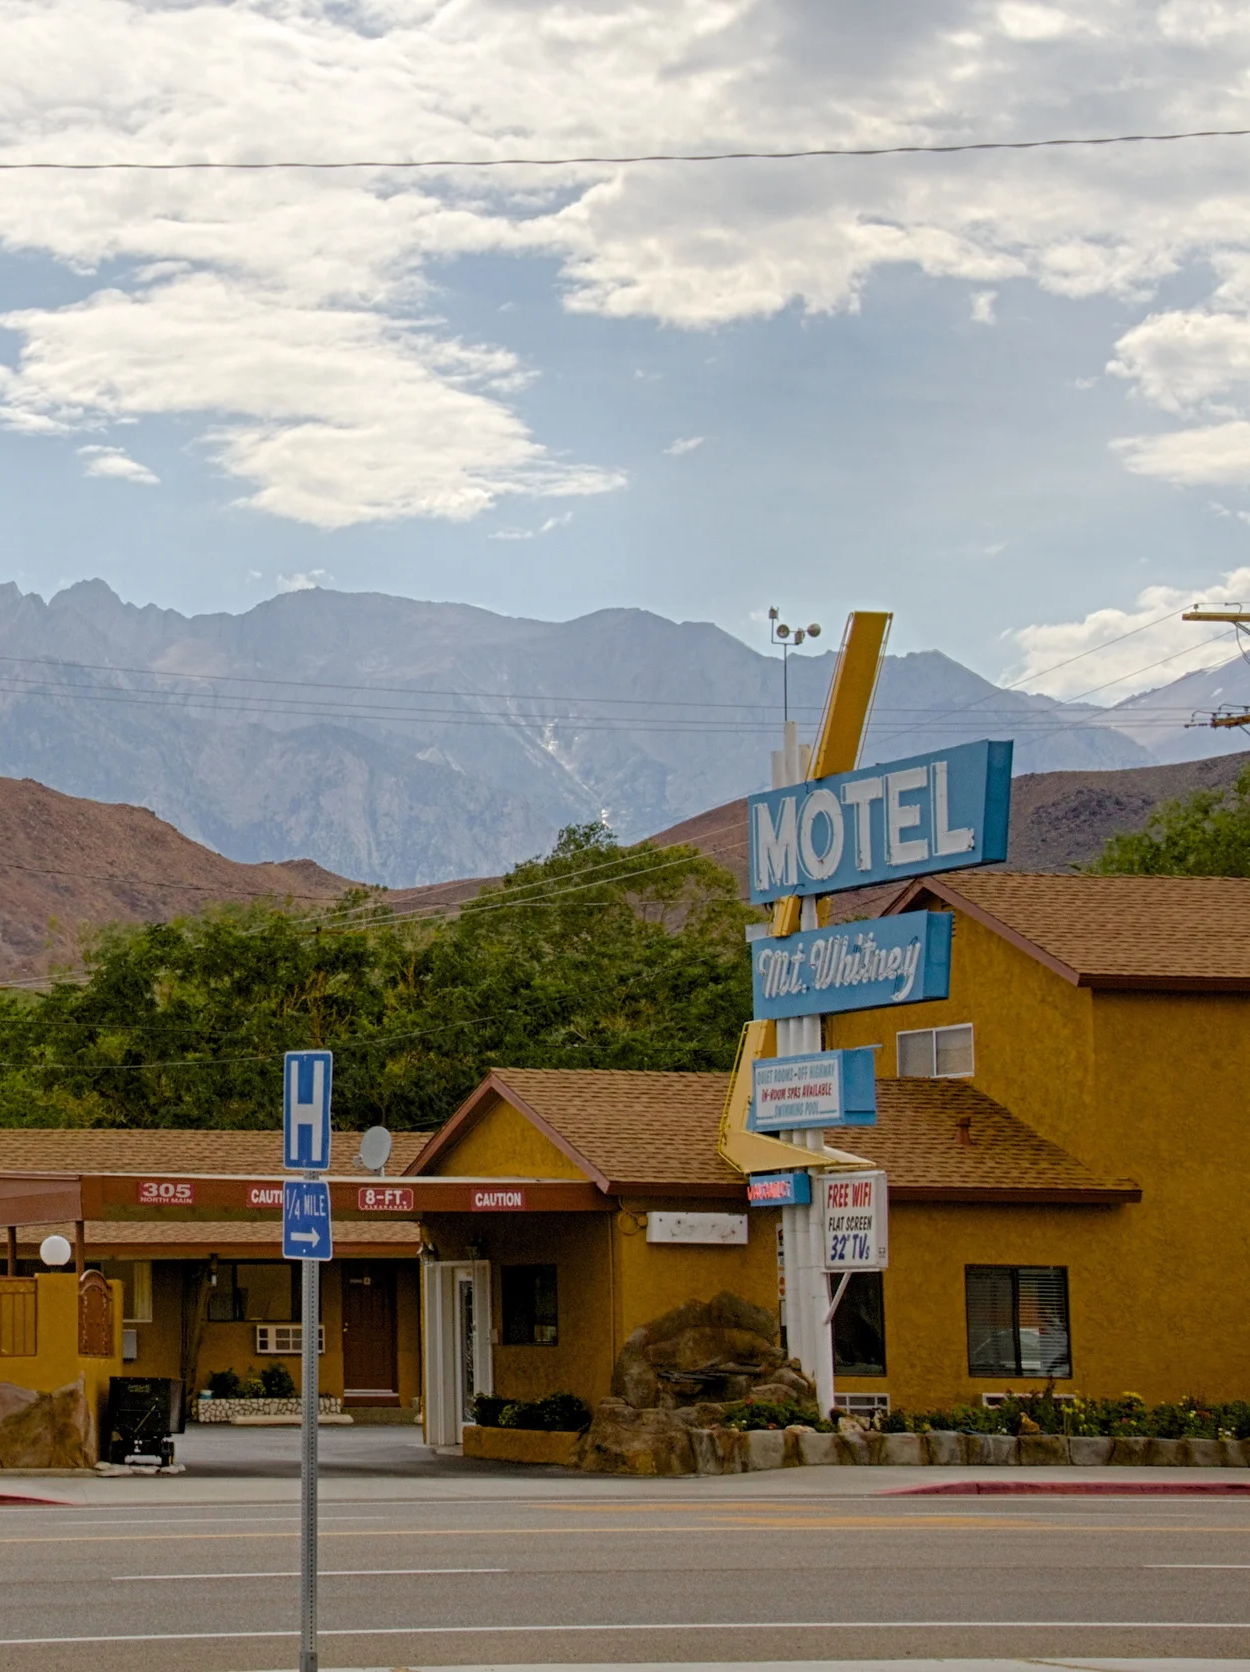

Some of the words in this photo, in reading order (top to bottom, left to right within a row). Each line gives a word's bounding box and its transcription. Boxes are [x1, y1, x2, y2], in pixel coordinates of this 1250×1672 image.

[752, 760, 975, 892] MOTEL
[757, 942, 808, 998] Mt.
[809, 931, 922, 1002] Whitney
[797, 1065, 808, 1080] OFF
[787, 1086, 801, 1099] SPAS
[802, 1082, 832, 1097] AVAILABLE
[290, 1060, 325, 1162] H
[142, 1182, 191, 1198] 305
[251, 1188, 283, 1204] CAUTI
[365, 1189, 407, 1205] 8-FT.
[827, 1183, 849, 1209] FREE
[852, 1181, 872, 1208] WIFI
[303, 1194, 327, 1217] MILE
[475, 1192, 522, 1207] CAUTION
[828, 1216, 845, 1232] FLAT
[845, 1214, 873, 1232] SCREEN
